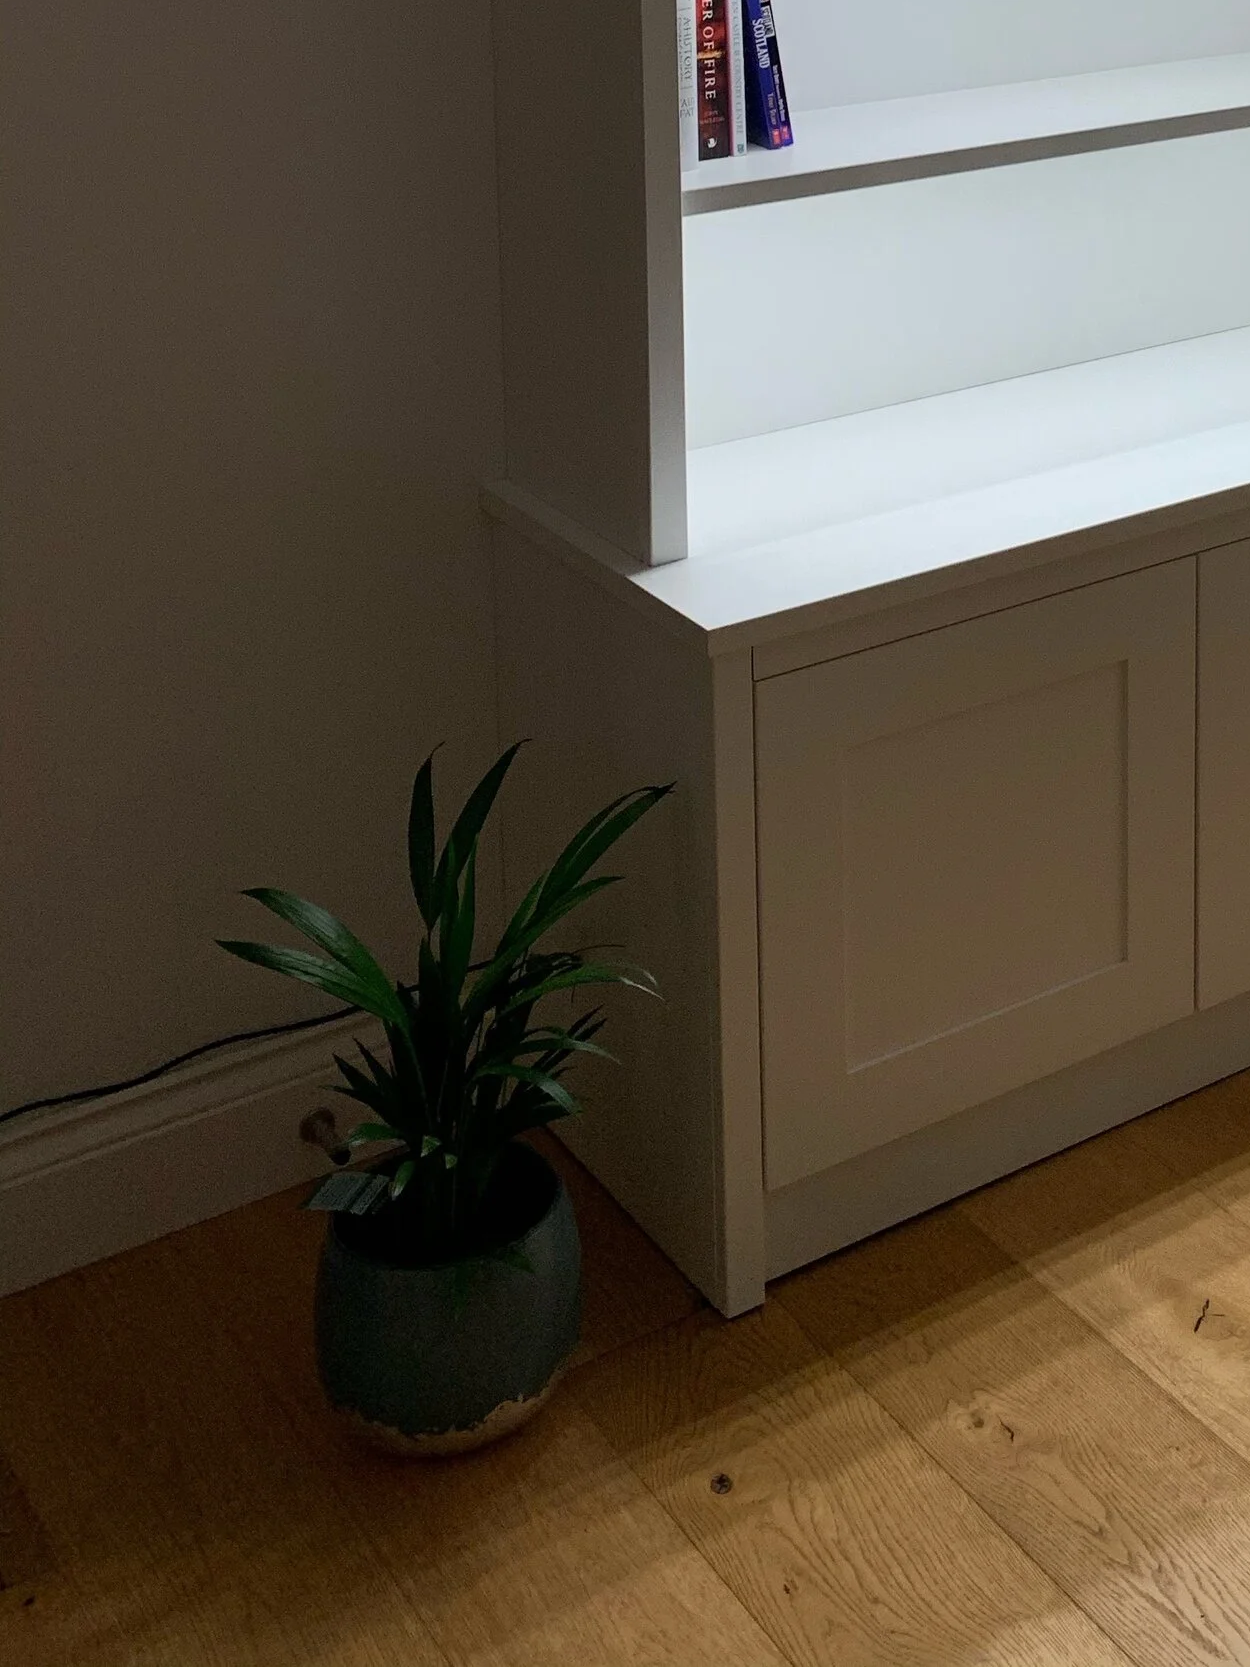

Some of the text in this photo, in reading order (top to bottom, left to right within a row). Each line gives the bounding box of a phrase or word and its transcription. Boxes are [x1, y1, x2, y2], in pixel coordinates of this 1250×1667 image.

[703, 26, 715, 53] OF
[752, 18, 770, 69] SCOTLAND
[704, 59, 716, 101] FIRE
